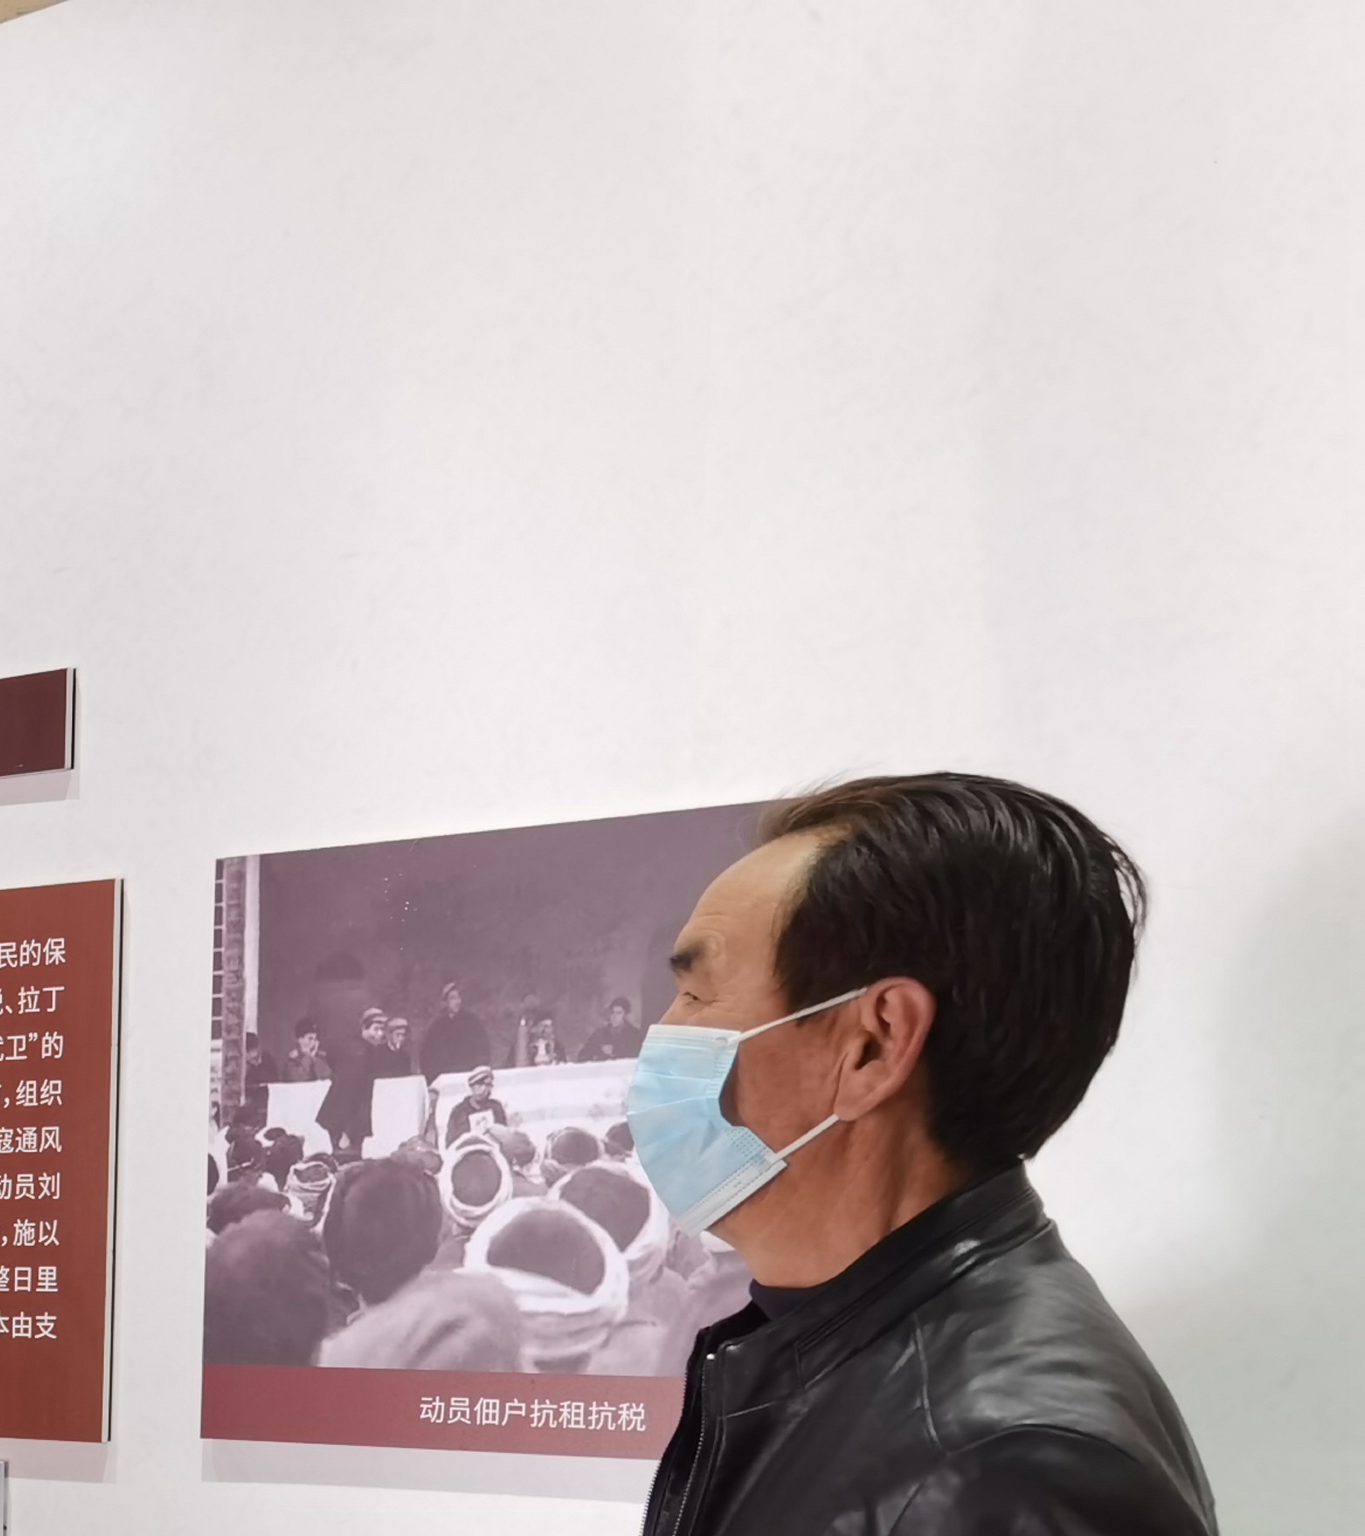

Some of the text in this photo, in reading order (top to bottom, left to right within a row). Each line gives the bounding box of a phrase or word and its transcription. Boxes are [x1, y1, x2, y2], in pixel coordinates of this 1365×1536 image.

[419, 1395, 647, 1432] 动员佃户抗租抗税
